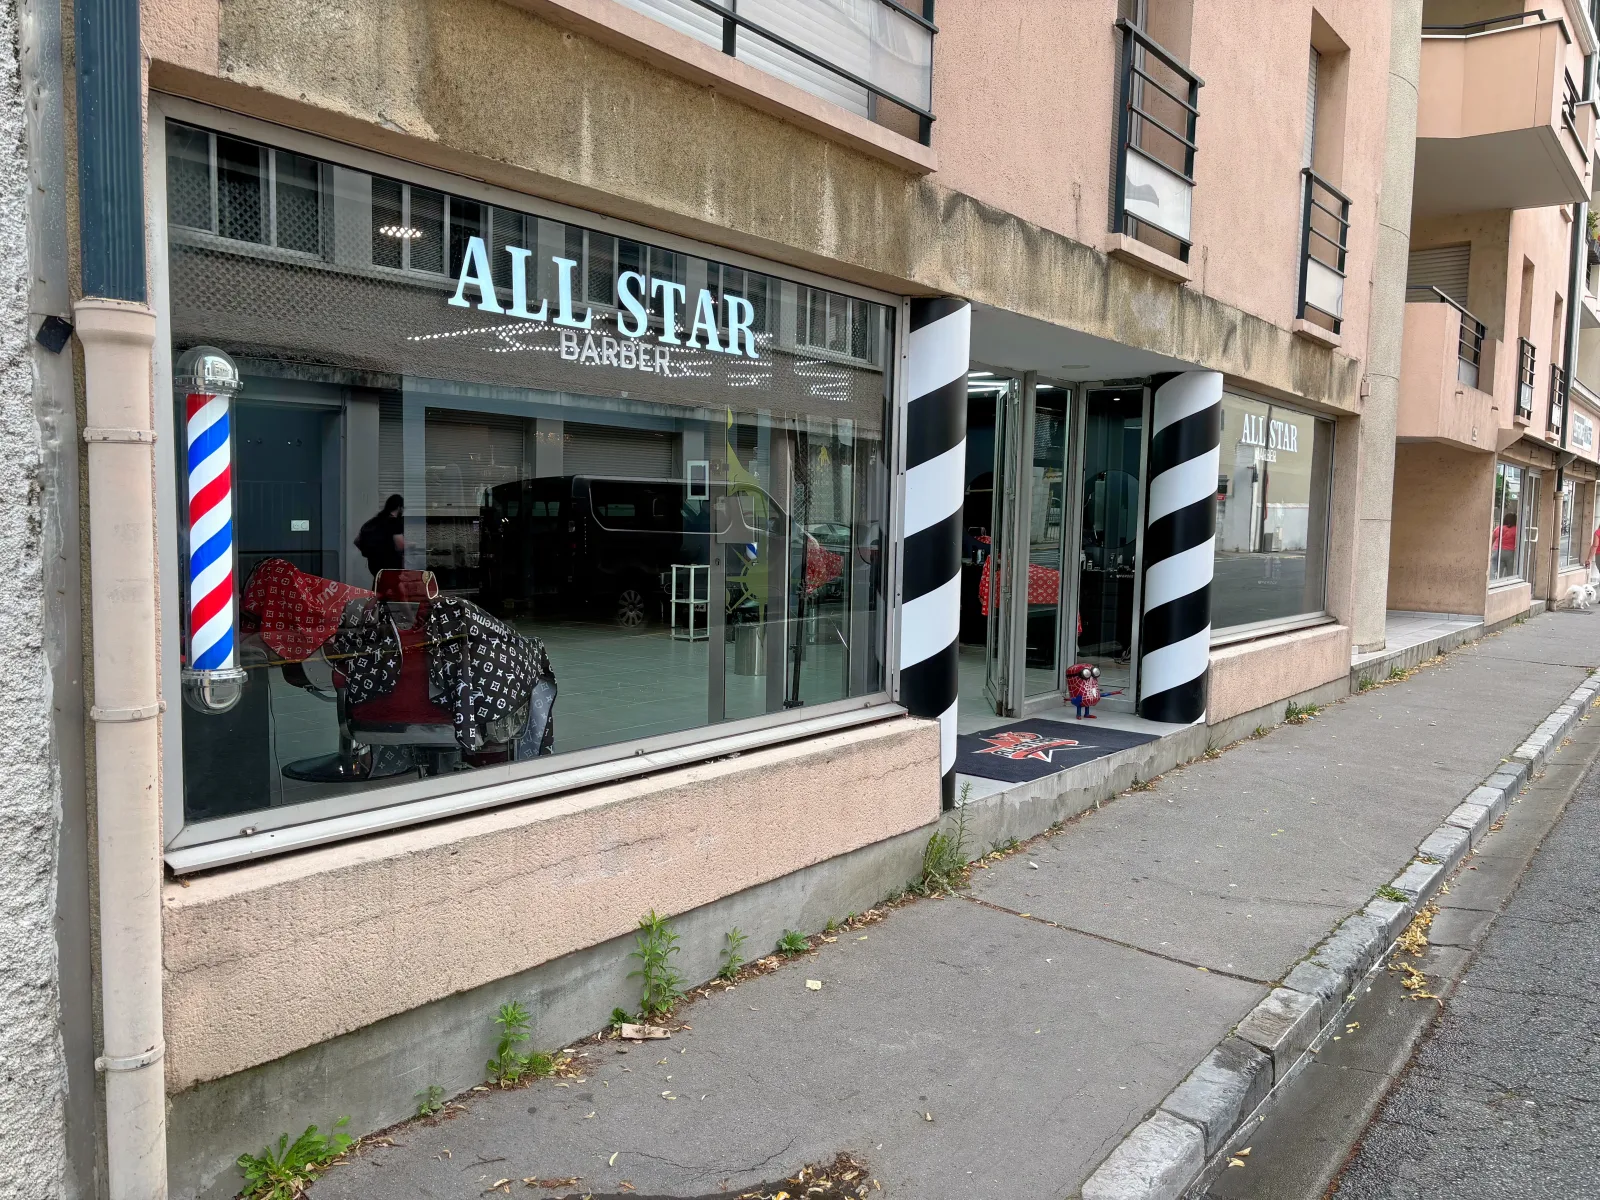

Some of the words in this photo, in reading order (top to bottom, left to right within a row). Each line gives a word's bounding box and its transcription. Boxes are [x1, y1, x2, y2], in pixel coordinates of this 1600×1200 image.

[447, 235, 592, 330] ALL
[617, 270, 760, 359] STAR
[560, 330, 671, 376] BARBER
[1241, 413, 1266, 447] ALL
[1269, 419, 1298, 453] STAR
